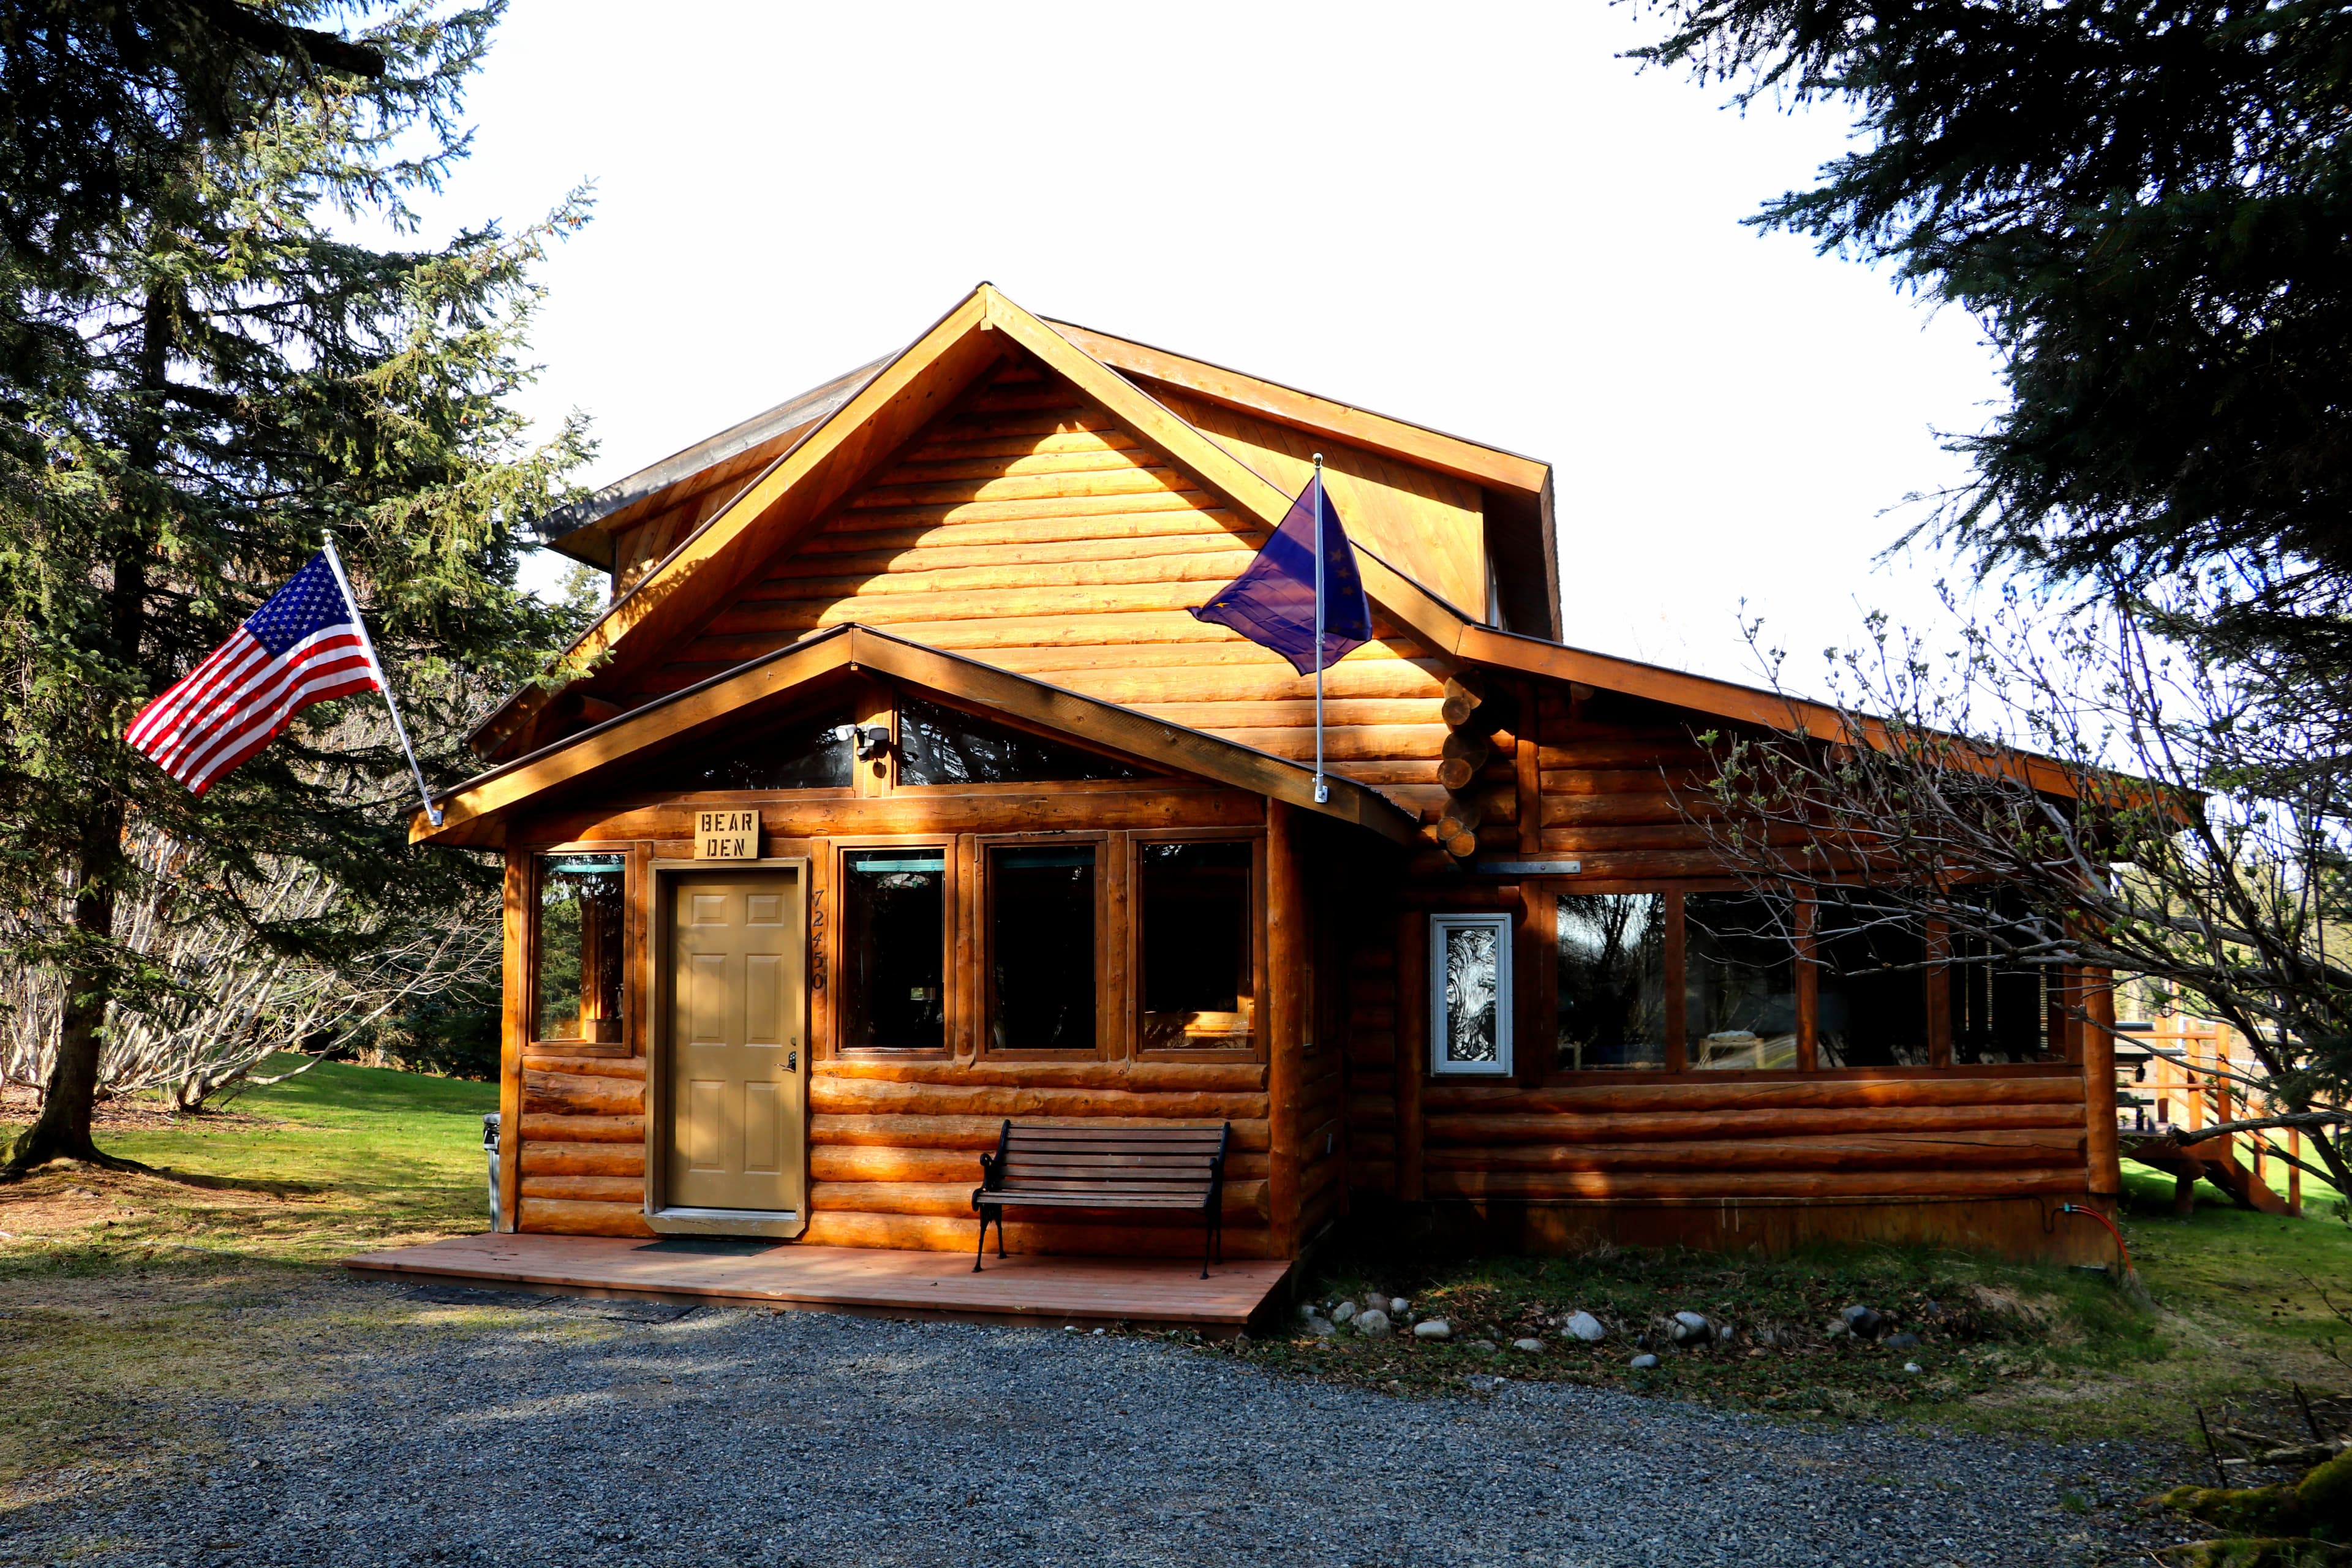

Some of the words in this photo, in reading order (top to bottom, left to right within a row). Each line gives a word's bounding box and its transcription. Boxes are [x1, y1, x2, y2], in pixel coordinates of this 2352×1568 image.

[701, 813, 752, 832] BEAR
[707, 839, 745, 857] DEN
[812, 889, 824, 990] 72450
